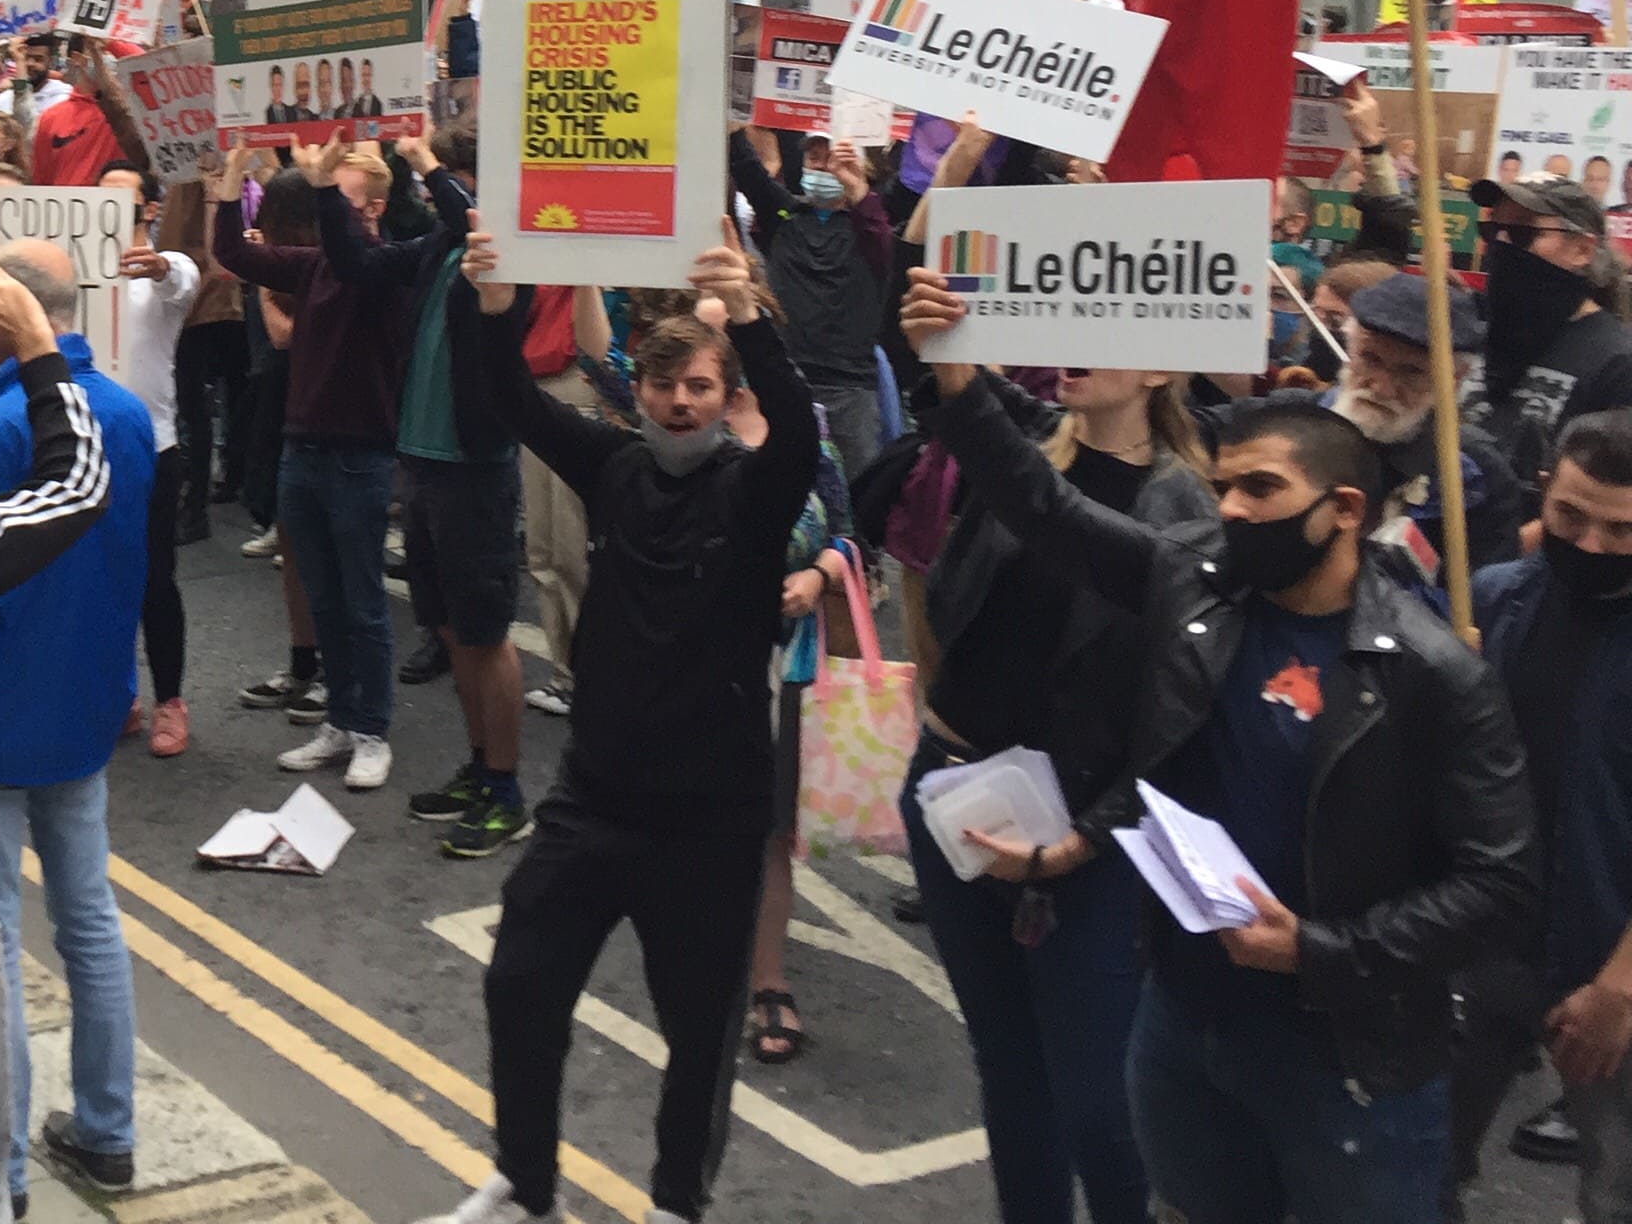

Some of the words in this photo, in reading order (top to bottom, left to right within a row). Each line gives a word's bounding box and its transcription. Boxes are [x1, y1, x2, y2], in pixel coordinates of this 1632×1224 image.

[529, 1, 658, 24] IRELAND'S
[528, 25, 641, 46] HOUSING
[528, 47, 609, 69] CRISIS
[773, 41, 833, 63] MICA
[526, 70, 618, 91] PUBLIC
[854, 39, 958, 80] DIVERSITY
[966, 69, 1010, 94] NOT
[1015, 83, 1116, 123] DIVISION
[526, 92, 640, 114] HOUSING
[526, 115, 549, 136] IS
[557, 114, 606, 136] THE
[525, 137, 650, 160] SOLUTION
[965, 299, 1062, 320] VERSITY
[1071, 301, 1124, 320] NOT
[1133, 301, 1254, 321] DIVISION
